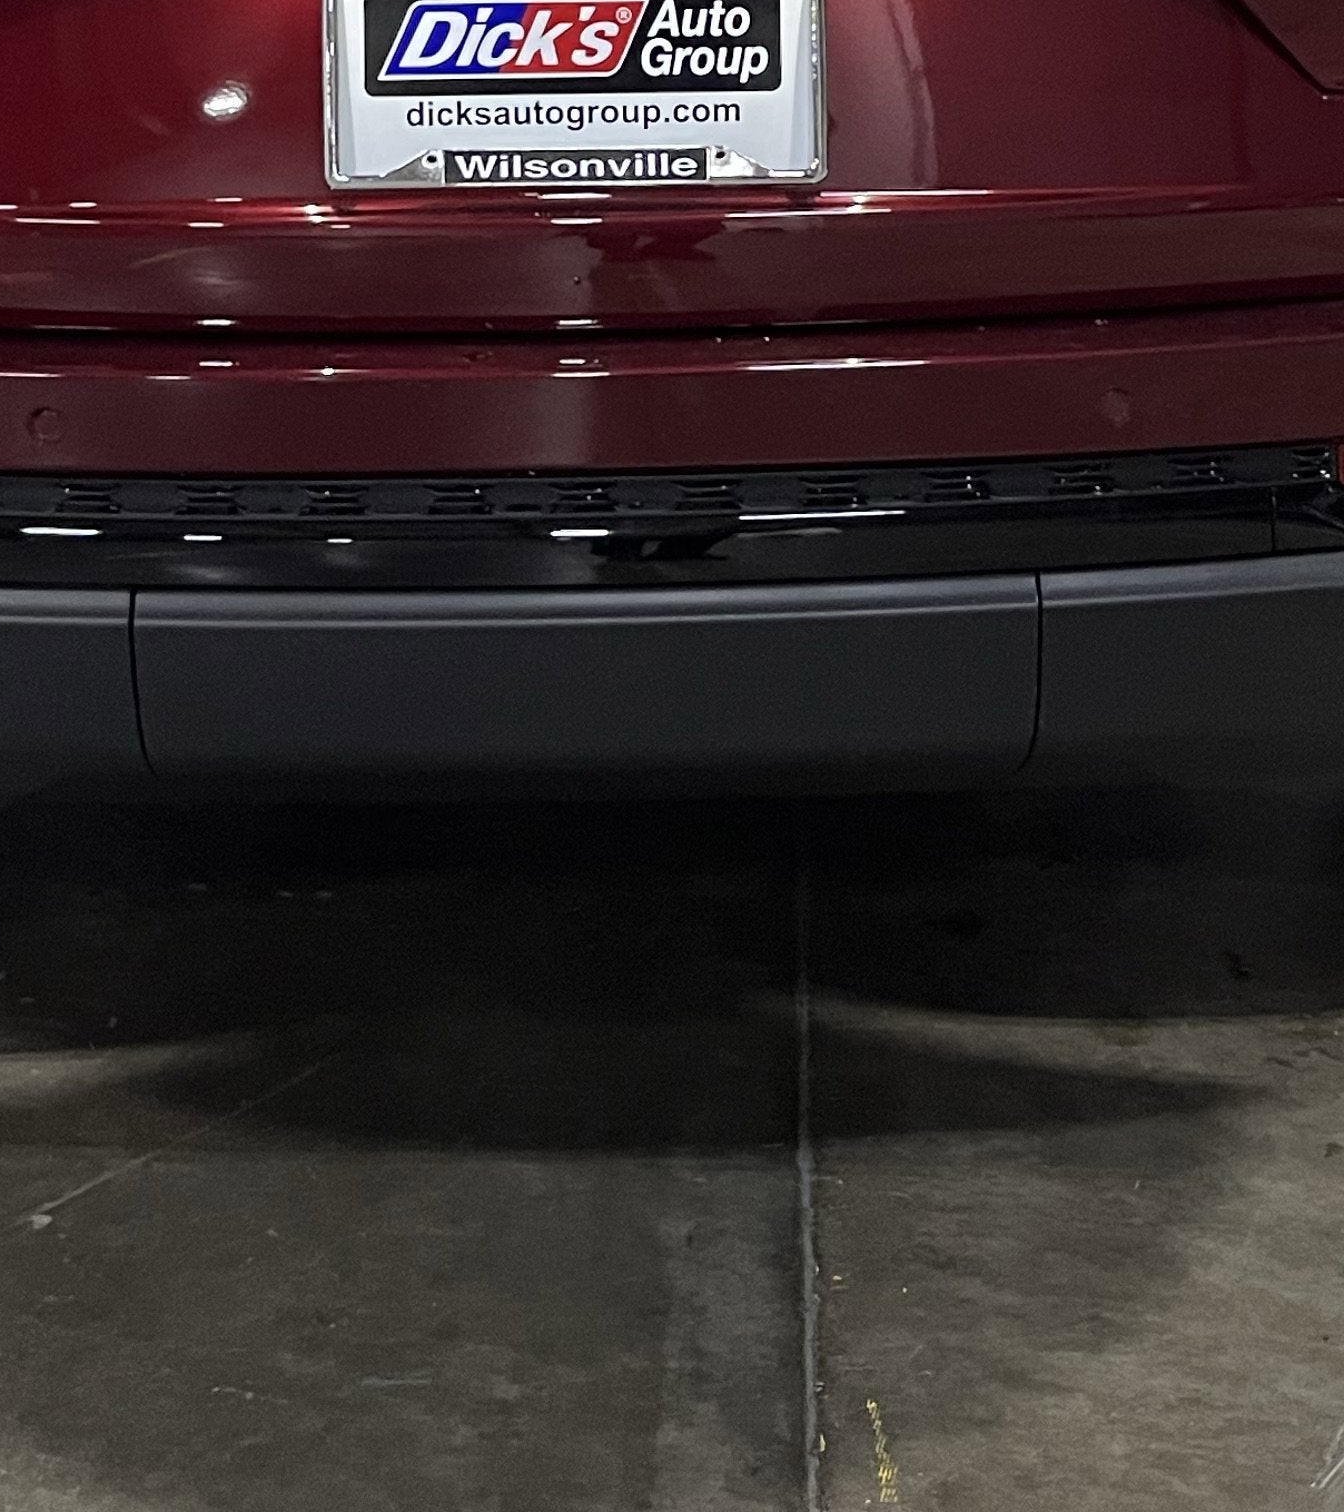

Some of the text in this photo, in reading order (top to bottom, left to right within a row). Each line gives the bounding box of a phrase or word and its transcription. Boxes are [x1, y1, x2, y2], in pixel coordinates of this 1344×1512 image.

[397, 6, 620, 69] Dick's
[640, 38, 771, 85] Group
[406, 99, 742, 131] dicksautogroup.com
[453, 152, 700, 182] Wilsonville
